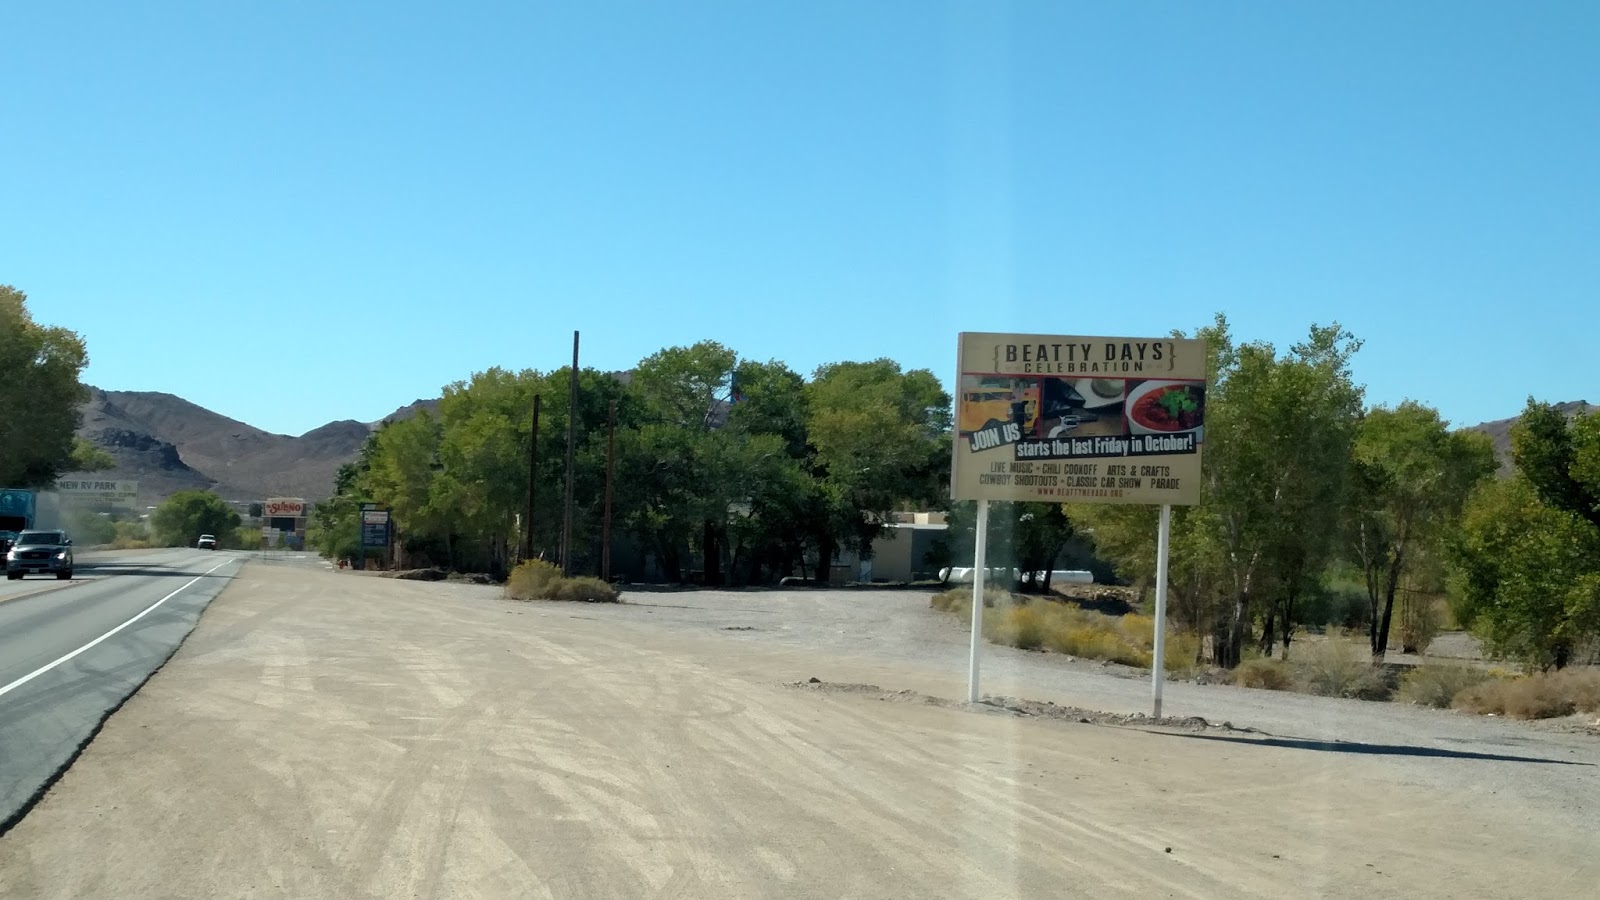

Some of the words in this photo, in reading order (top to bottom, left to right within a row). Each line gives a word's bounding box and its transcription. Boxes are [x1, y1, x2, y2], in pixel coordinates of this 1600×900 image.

[1006, 344, 1092, 362] BEATTY
[1105, 342, 1163, 361] DAYS
[1024, 361, 1143, 373] CELEBRATION
[971, 428, 1000, 451] JOIN
[1002, 422, 1021, 444] US
[1017, 442, 1050, 457] starts
[1052, 440, 1069, 456] the
[1072, 439, 1094, 455] last
[1094, 438, 1129, 456] Friday
[1131, 436, 1142, 452] in
[1144, 432, 1193, 451] October!
[990, 462, 1006, 473] LIVE
[1009, 462, 1034, 474] MUSIC
[1042, 463, 1061, 474] CHILI
[1063, 463, 1098, 475] COOKOFF
[1106, 465, 1127, 476] ARTS
[1129, 465, 1137, 476] &
[1140, 465, 1170, 477] CRAFTS
[60, 481, 79, 490] NEW
[81, 481, 93, 490] RV
[95, 482, 117, 491] PARK
[979, 474, 1012, 485] COWBOY
[1014, 475, 1058, 487] SHOOTOUTS
[1066, 476, 1098, 488] CLASSIC
[1100, 477, 1116, 488] CAR
[1118, 477, 1142, 489] SHOW
[1150, 478, 1180, 490] PARADE
